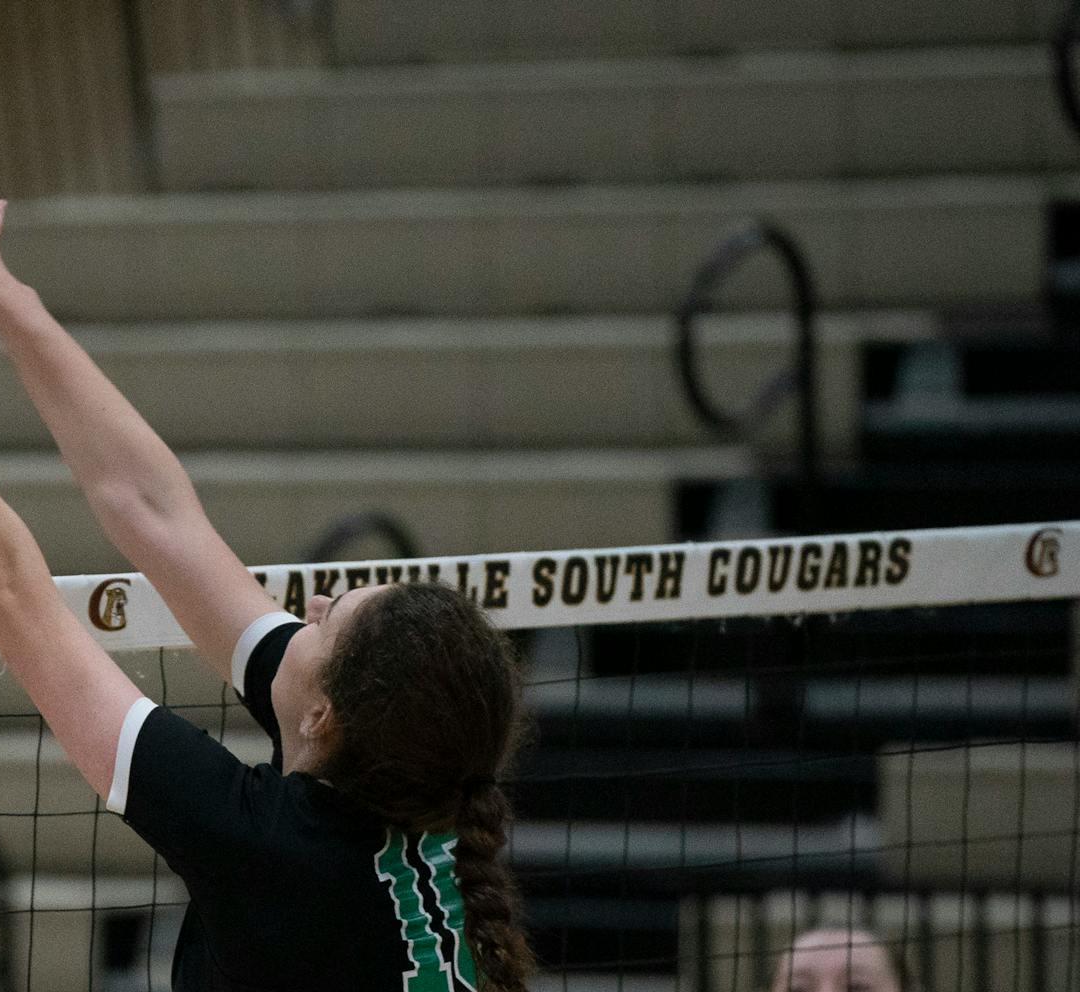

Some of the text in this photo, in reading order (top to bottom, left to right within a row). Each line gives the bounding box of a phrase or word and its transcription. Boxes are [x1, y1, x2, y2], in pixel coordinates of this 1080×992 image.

[253, 538, 913, 620] AKELE SOUTH COUGARS
